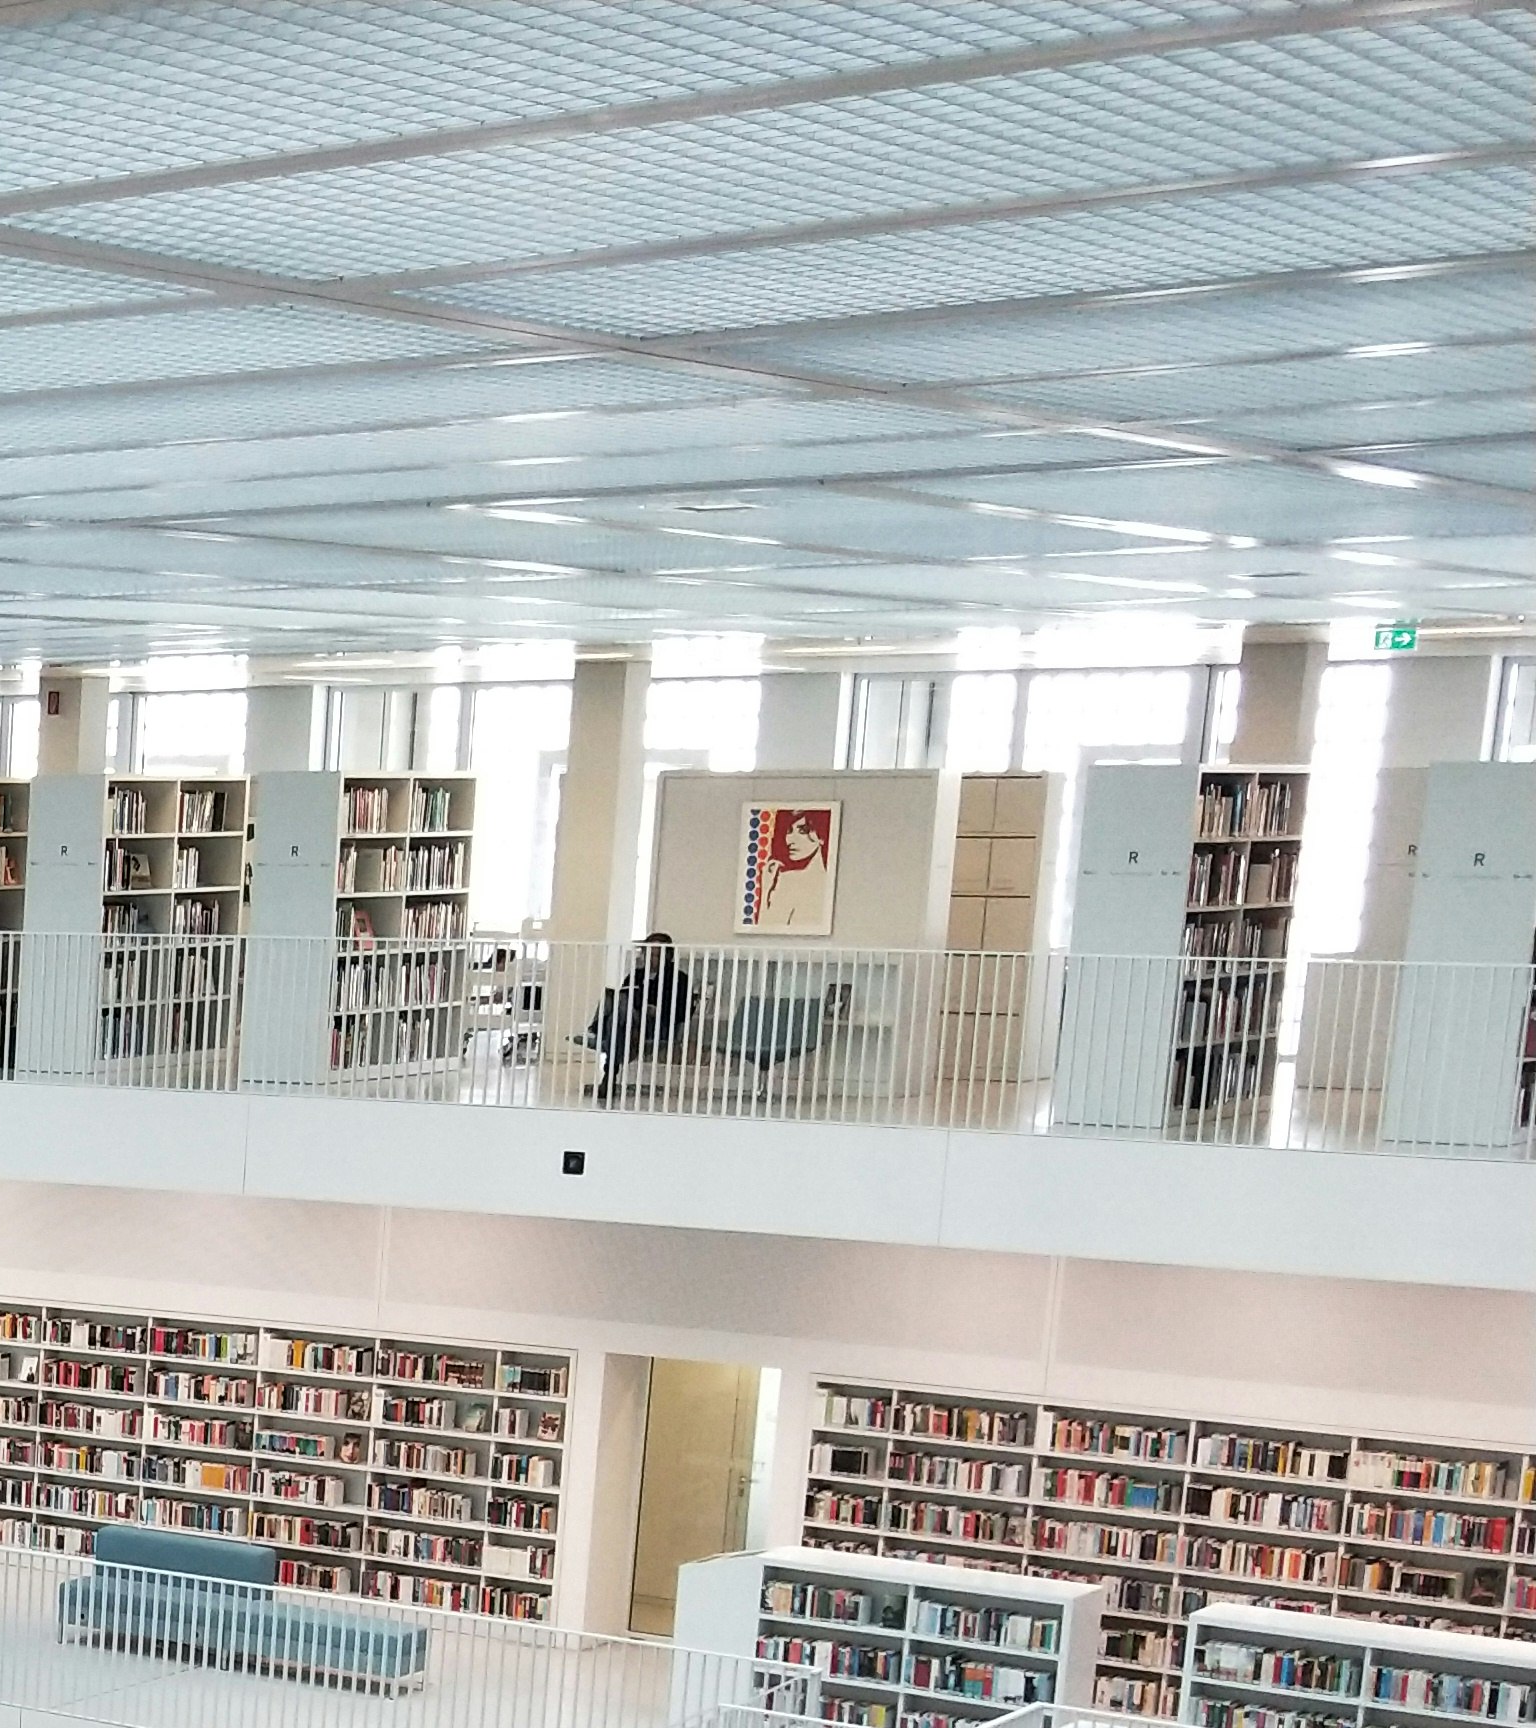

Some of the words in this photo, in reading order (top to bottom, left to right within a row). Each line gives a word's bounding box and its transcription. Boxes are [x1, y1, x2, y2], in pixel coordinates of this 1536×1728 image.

[60, 846, 67, 856] R
[291, 846, 298, 857] R
[1407, 845, 1417, 856] R
[1128, 852, 1138, 864] R
[1473, 853, 1485, 867] R
